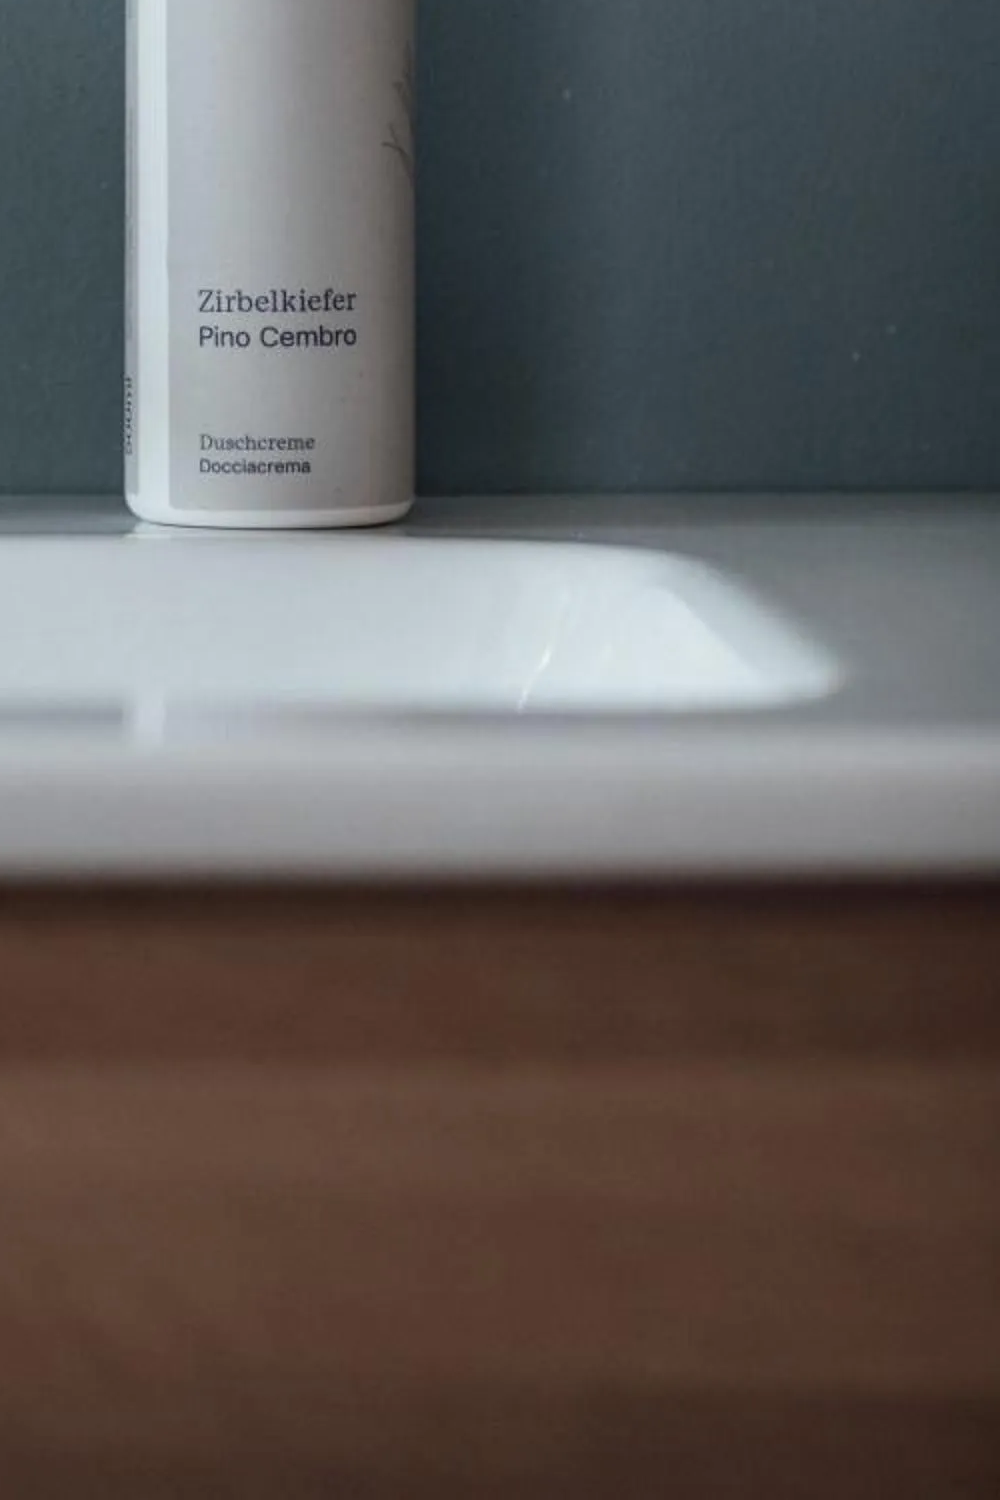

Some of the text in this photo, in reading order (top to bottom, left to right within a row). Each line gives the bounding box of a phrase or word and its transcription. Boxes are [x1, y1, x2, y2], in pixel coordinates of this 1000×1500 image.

[198, 289, 357, 313] Zirbelkiefer
[198, 325, 358, 348] Pino Cembro
[200, 434, 316, 451] Duschcreme
[199, 458, 312, 474] Docciacrema
